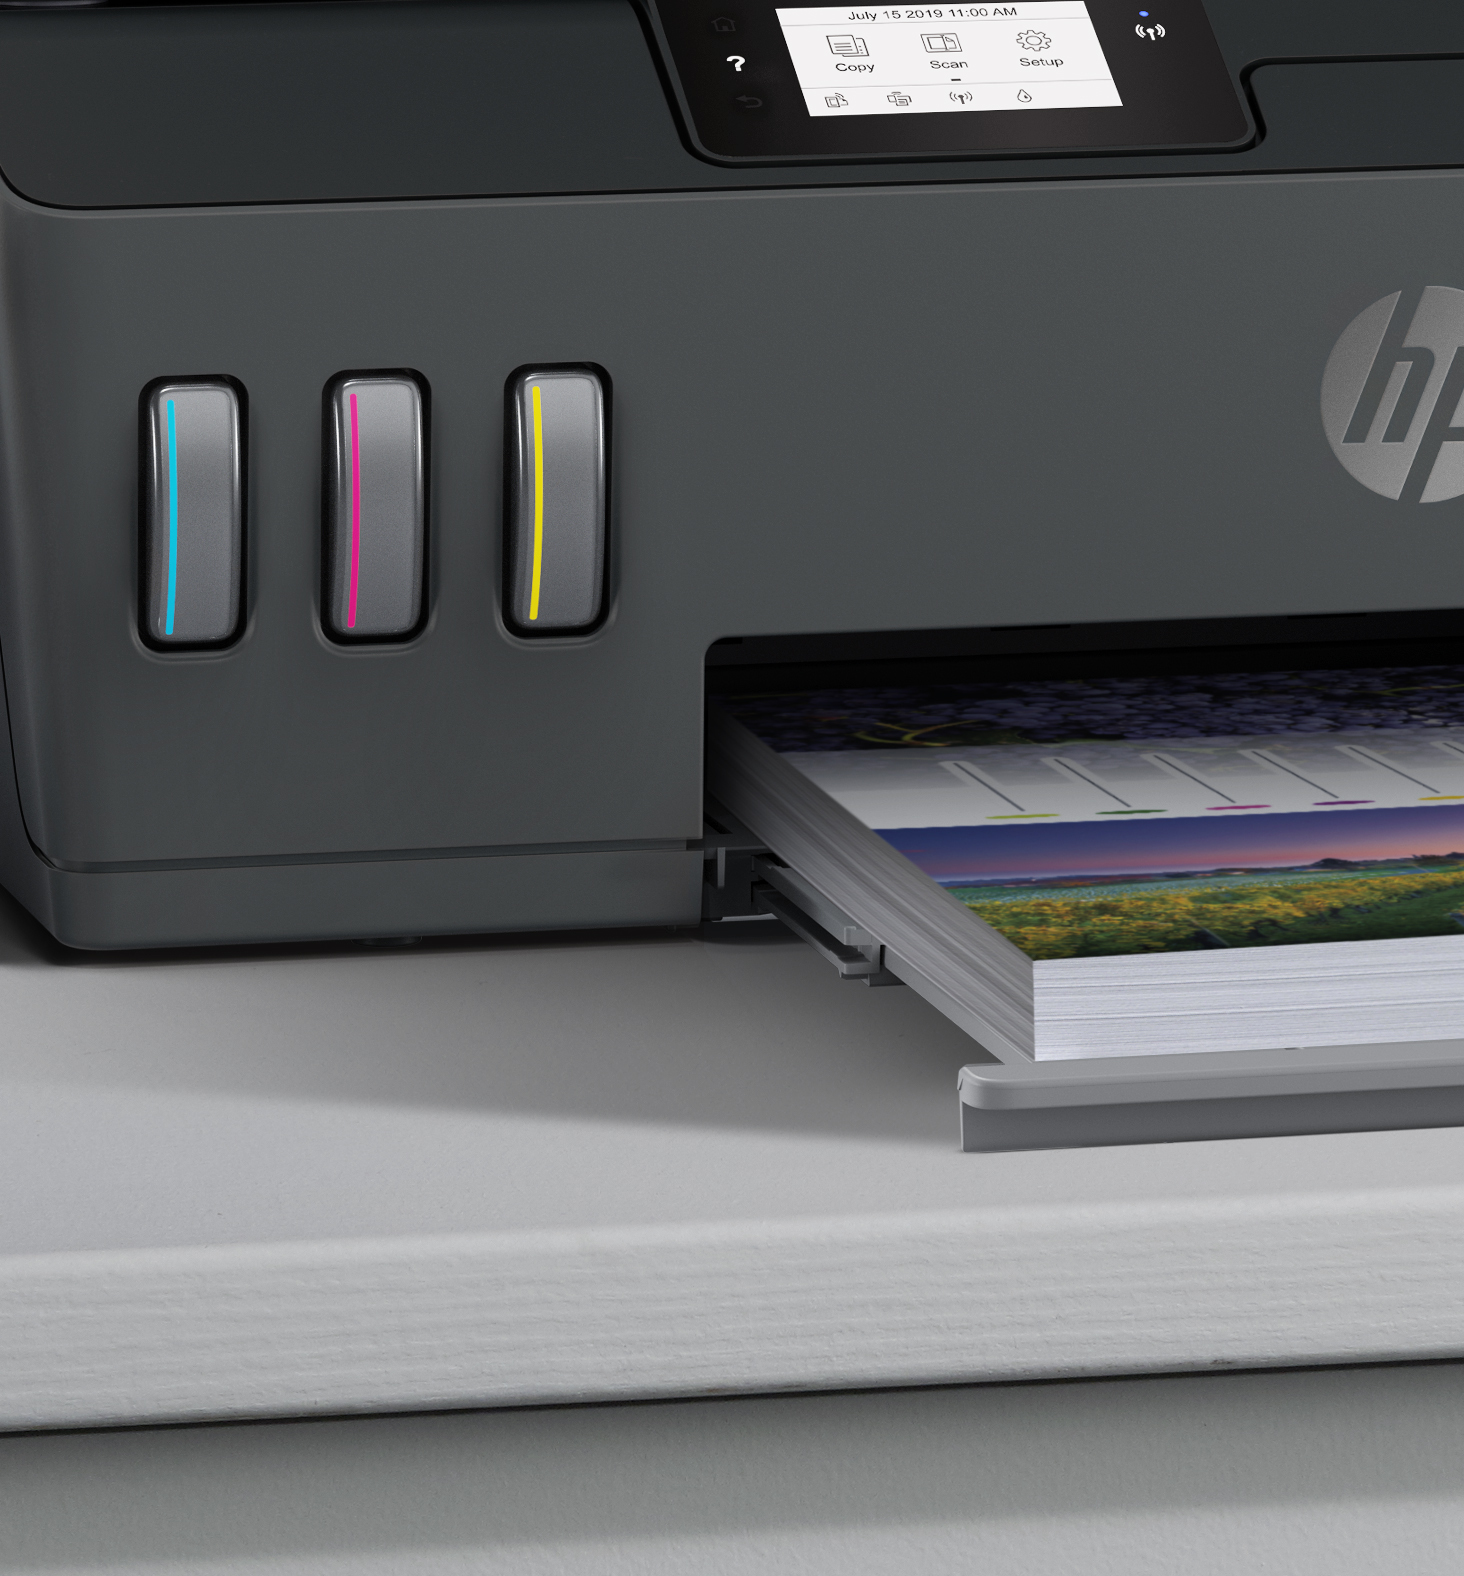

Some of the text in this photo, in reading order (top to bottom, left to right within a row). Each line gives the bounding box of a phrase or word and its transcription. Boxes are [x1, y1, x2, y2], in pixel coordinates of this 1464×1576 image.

[848, 7, 1018, 22] July 15 2019 11:00 AM
[930, 60, 969, 70] Scan
[1019, 58, 1064, 68] Setup
[835, 63, 875, 74] Copy
